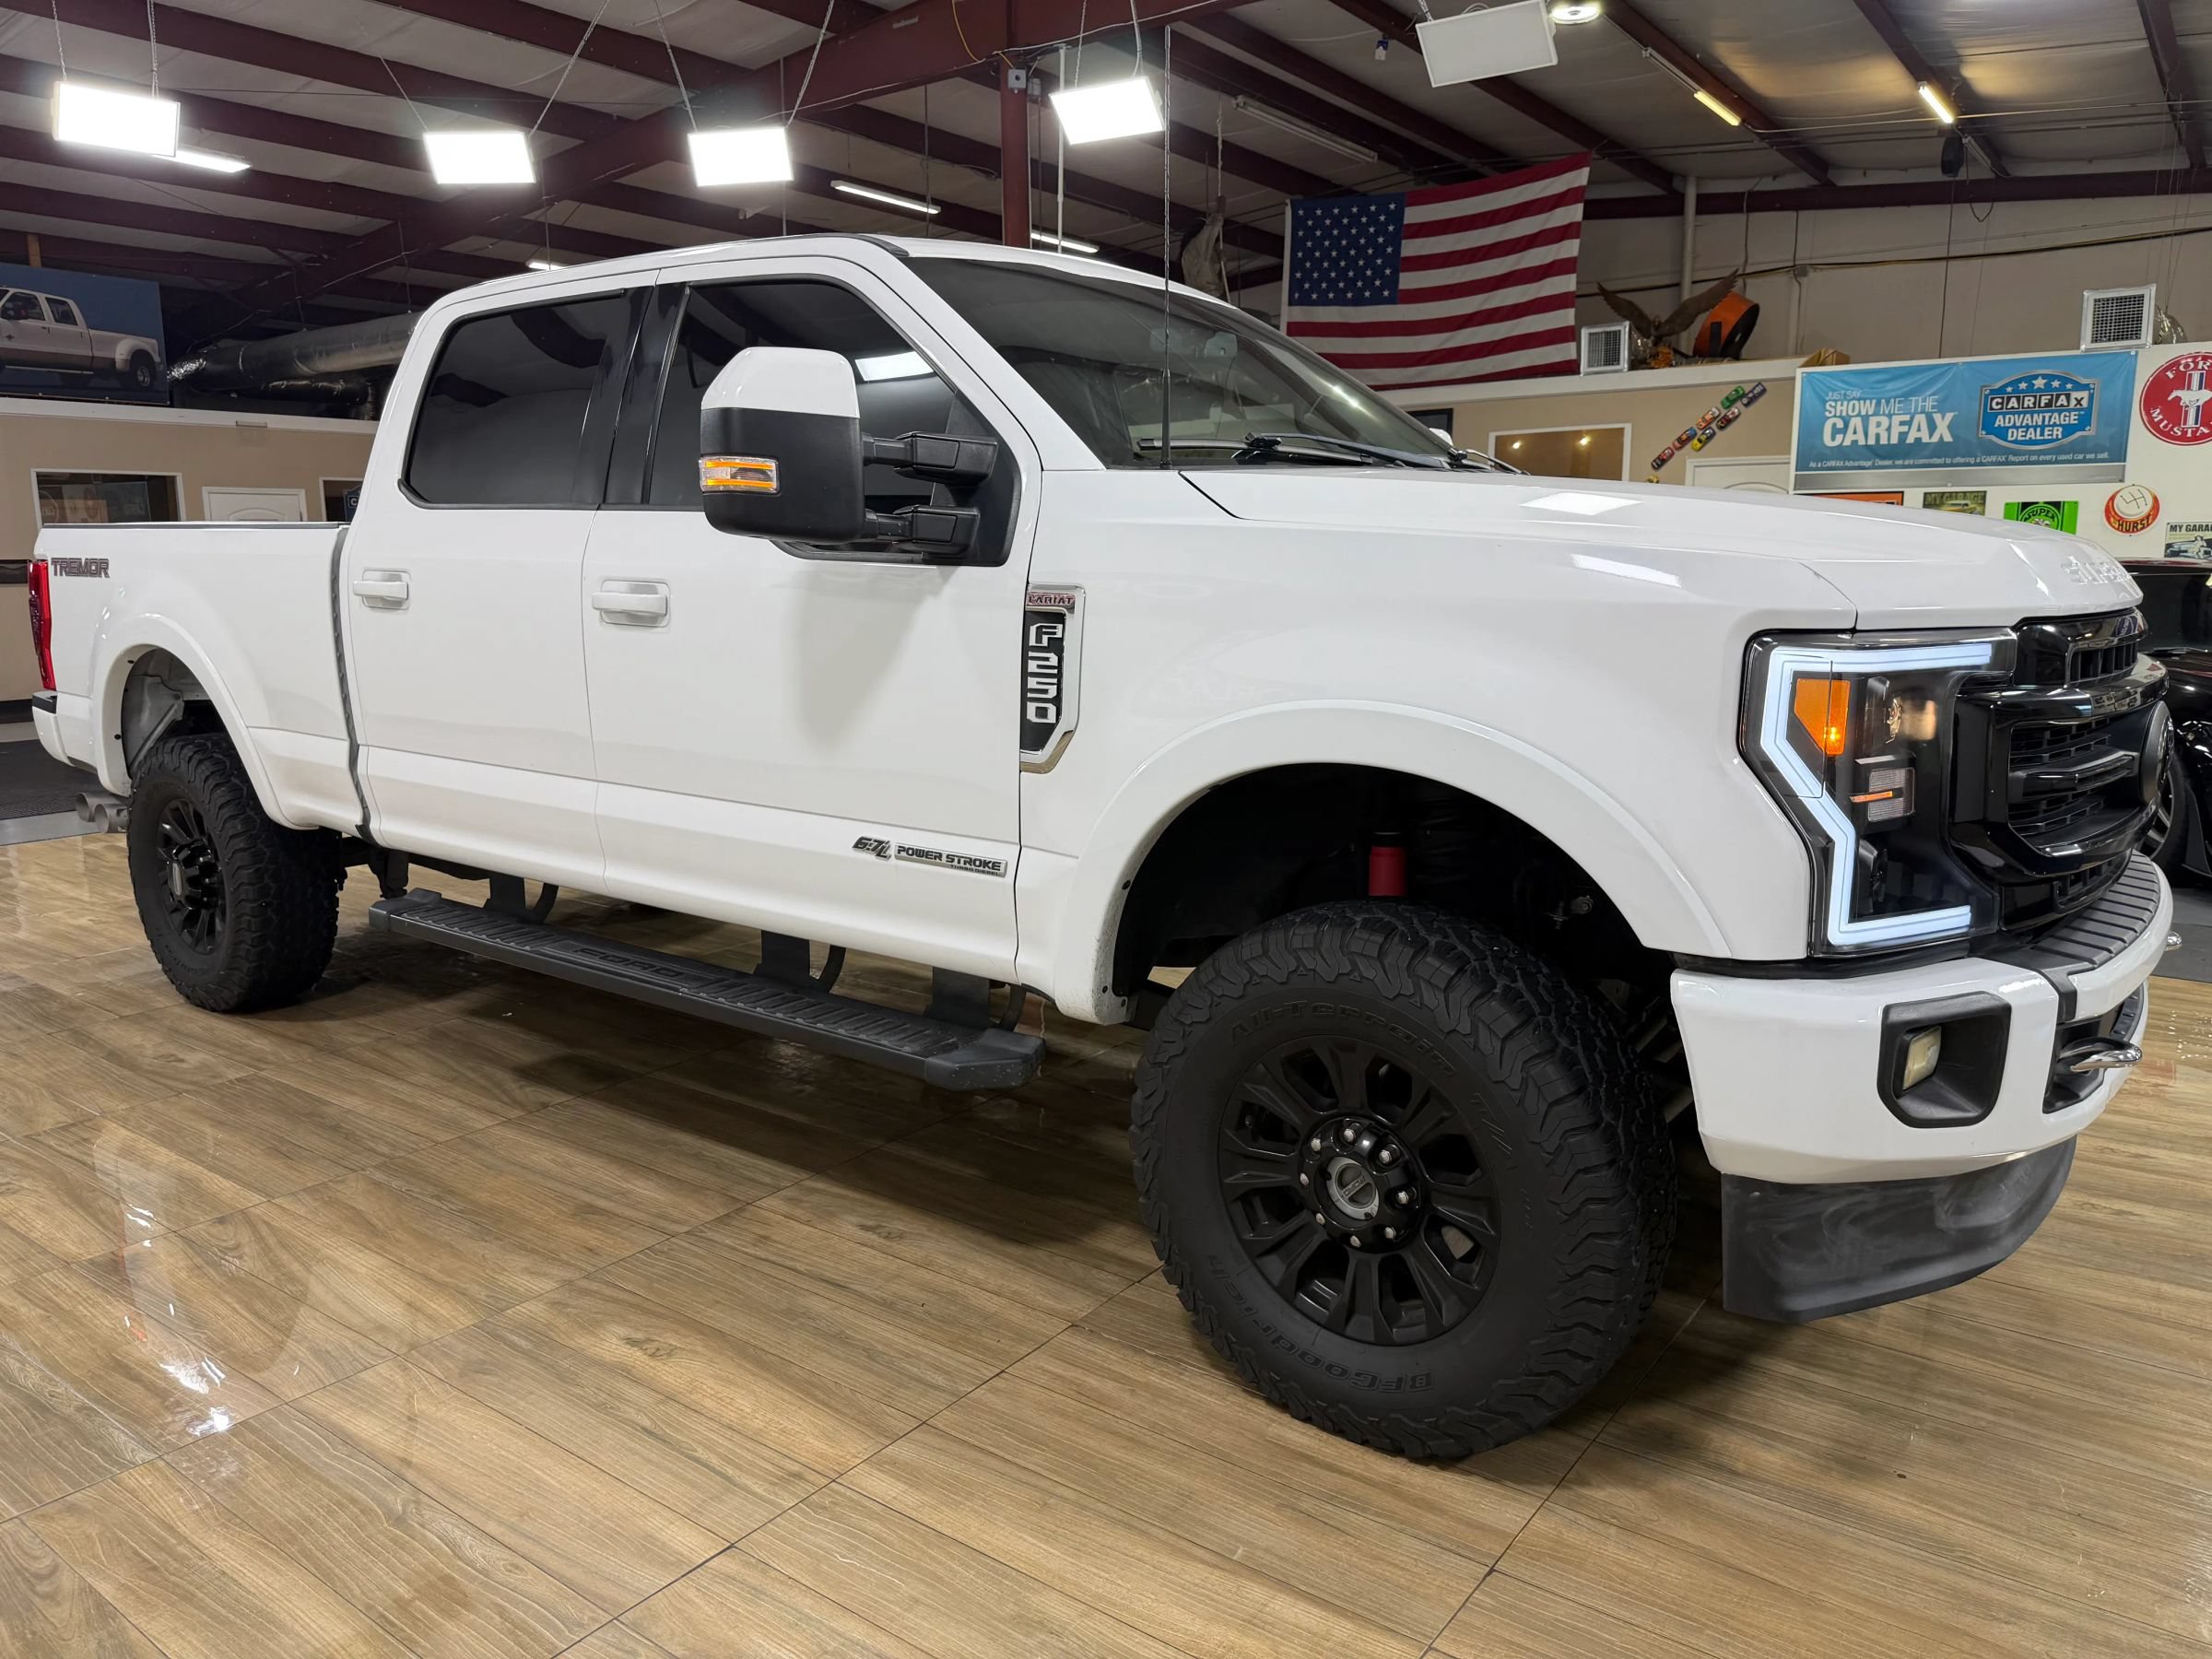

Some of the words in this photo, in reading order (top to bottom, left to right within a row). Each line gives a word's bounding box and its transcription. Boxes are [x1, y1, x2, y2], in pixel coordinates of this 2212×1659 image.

[2165, 359, 2212, 380] FOR
[1825, 391, 1844, 400] JUST
[1846, 390, 1862, 399] SAY
[1990, 394, 2086, 410] CARFAX
[1824, 399, 1877, 417] SHOW
[1880, 397, 1904, 415] ME
[1909, 396, 1939, 413] THE
[1994, 411, 2079, 428] ADVANTAGE
[2150, 406, 2212, 437] MUSTA
[1823, 412, 1955, 447] CARFAX
[2007, 427, 2063, 441] DEALER
[2039, 454, 2056, 463] every
[1924, 493, 1942, 505] MY
[2024, 508, 2056, 523] SUPER
[2117, 513, 2153, 533] HURST
[2169, 524, 2183, 533] MY
[2185, 524, 2212, 533] GARA
[51, 558, 110, 578] TREMOR
[1028, 592, 1077, 606] LARIAT
[897, 845, 943, 862] POWER
[946, 853, 1002, 871] STROKE
[571, 947, 685, 977] FORD
